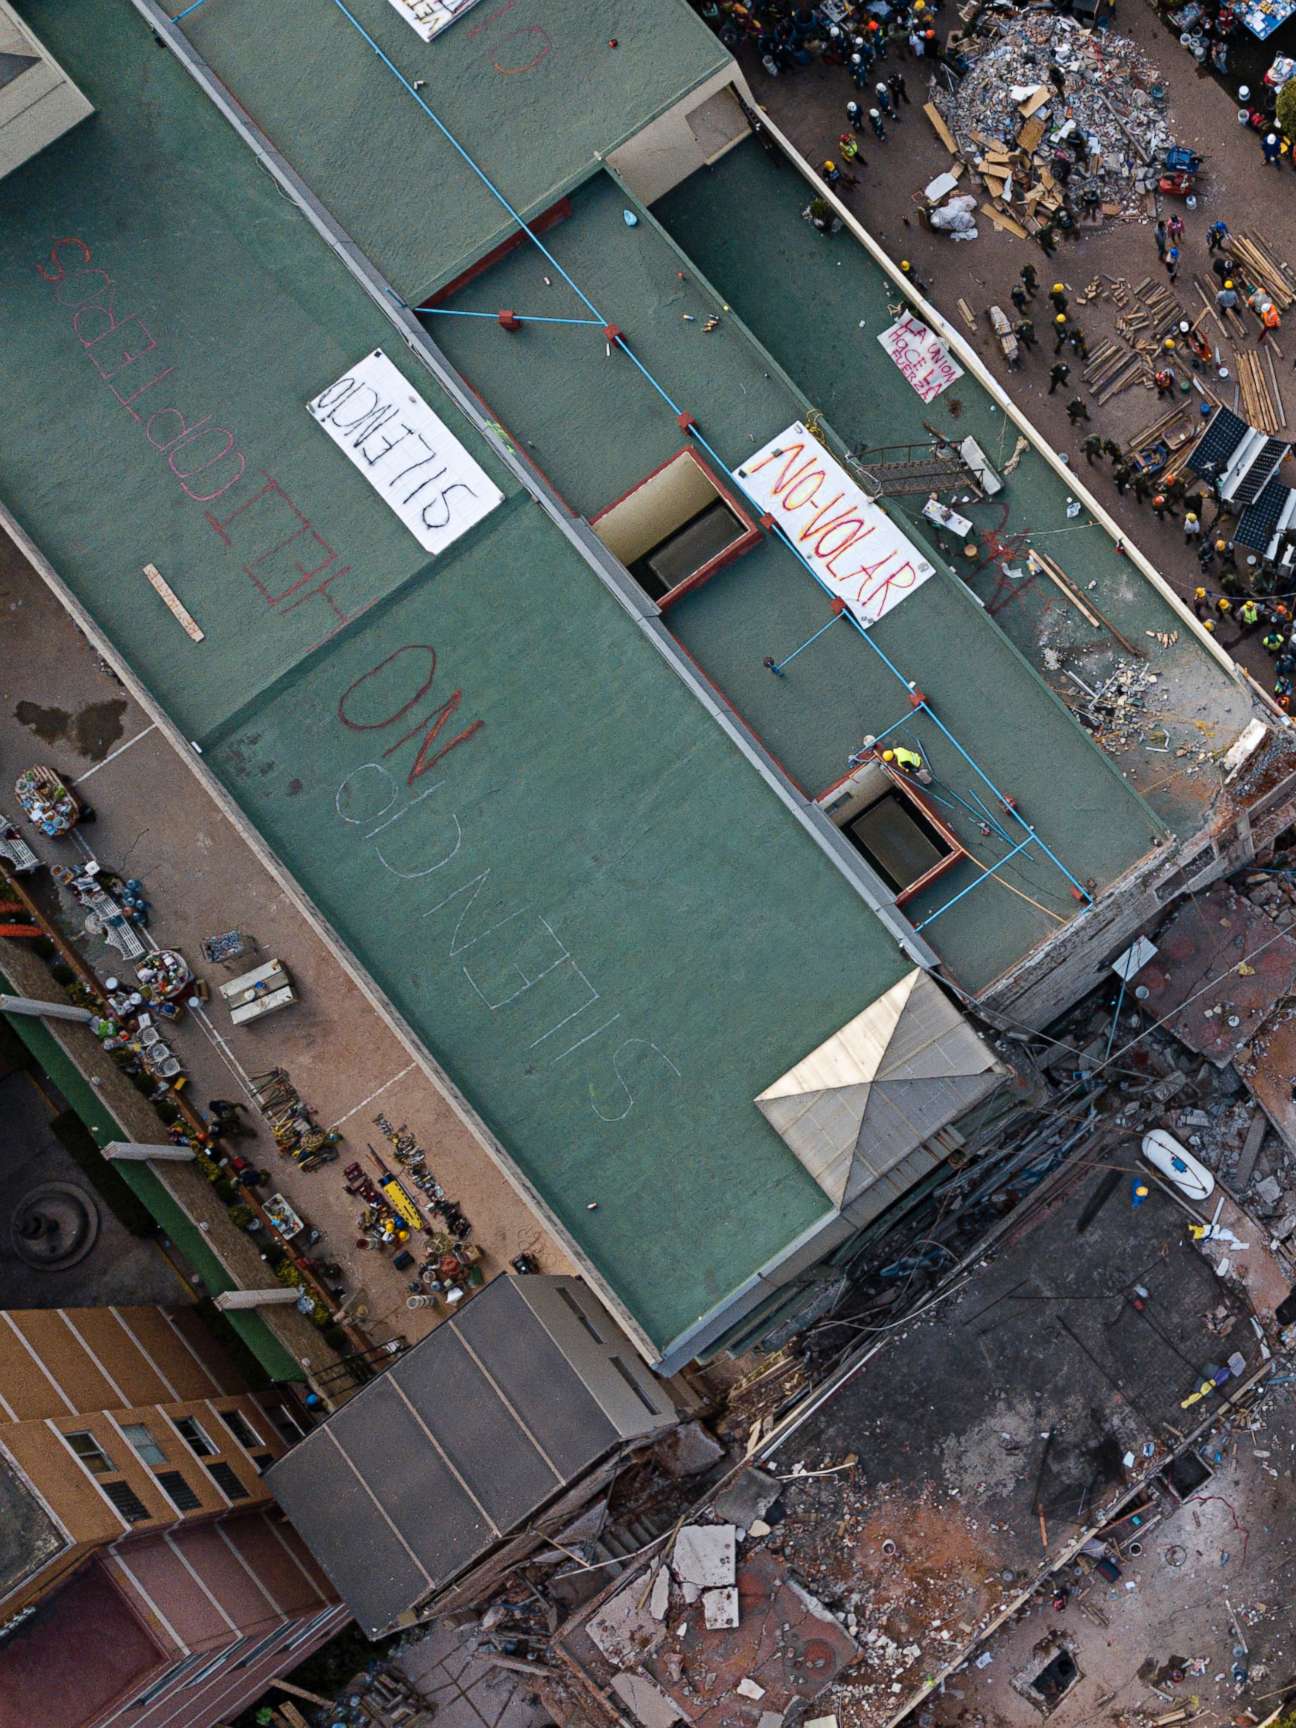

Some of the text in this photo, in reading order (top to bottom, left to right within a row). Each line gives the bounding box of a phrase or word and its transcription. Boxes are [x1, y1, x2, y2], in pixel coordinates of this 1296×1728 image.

[904, 318, 927, 344] LA
[36, 236, 378, 652] HELICOPTEROS
[317, 377, 479, 530] SILENCIO
[337, 644, 486, 785] NO
[335, 763, 682, 1122] SILENCIO
